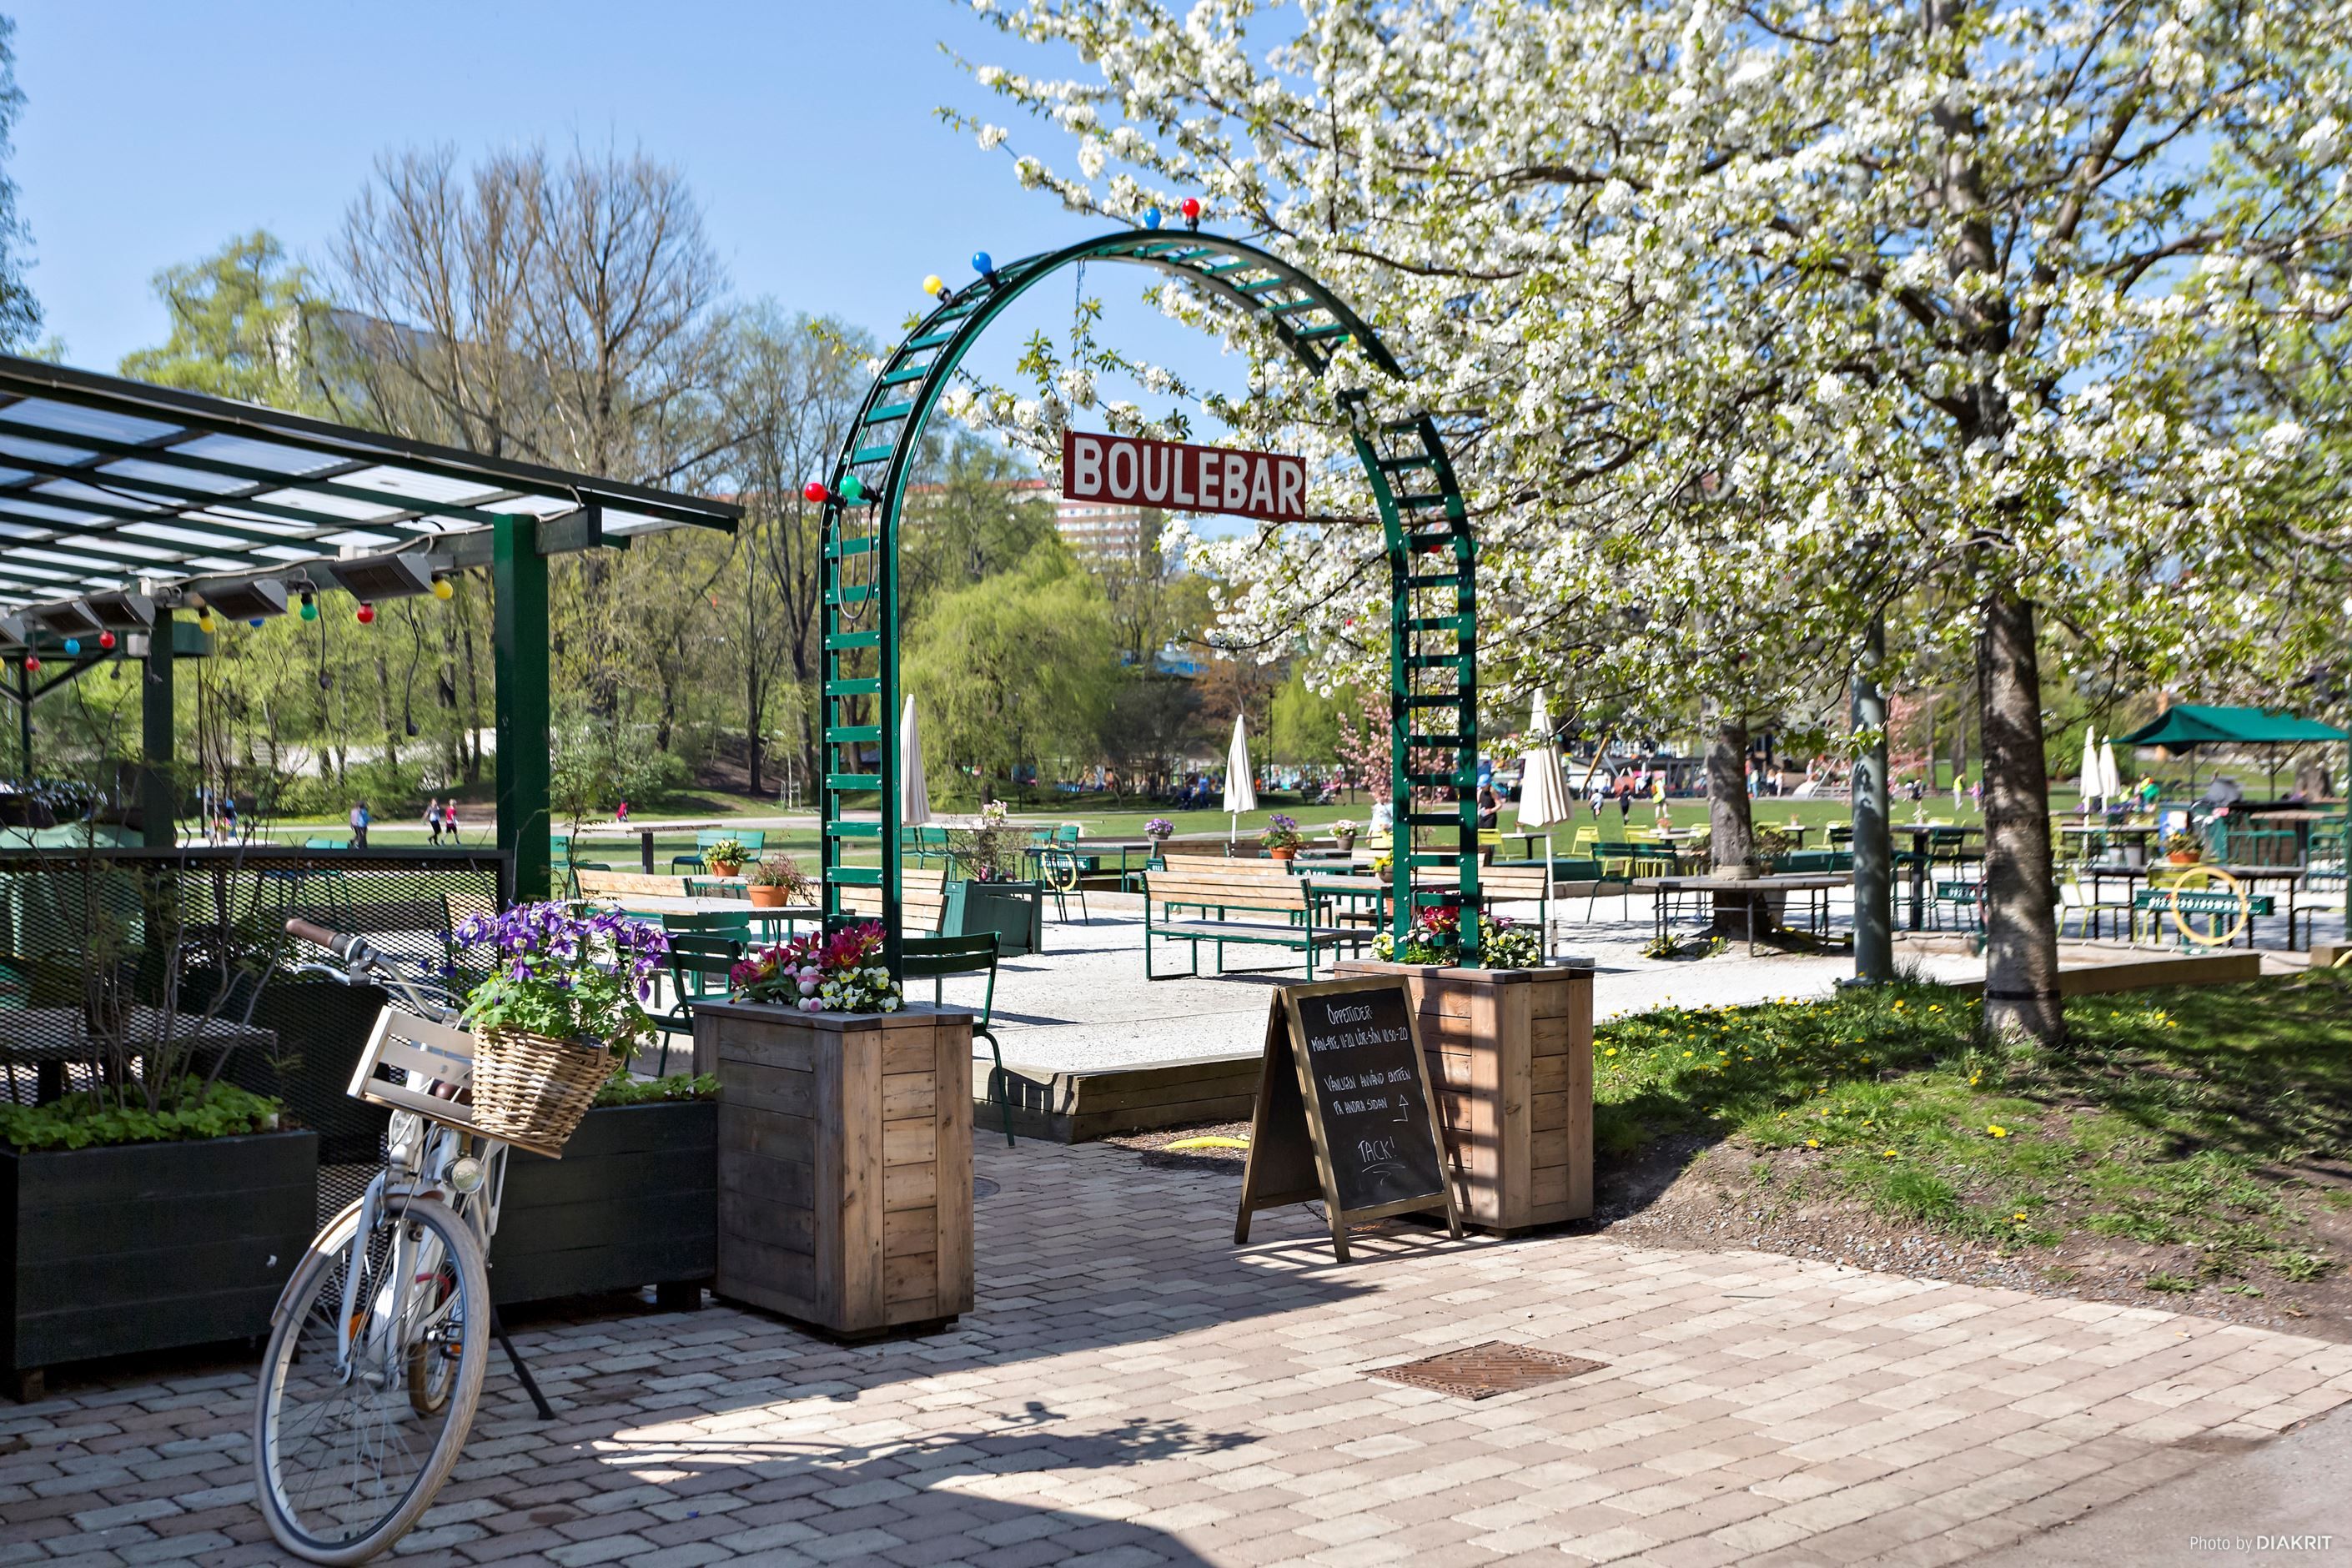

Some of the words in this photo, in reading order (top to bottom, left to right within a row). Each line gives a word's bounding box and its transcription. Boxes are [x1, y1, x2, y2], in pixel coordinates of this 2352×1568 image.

[1073, 436, 1304, 515] BOULEBAR
[1344, 1099, 1366, 1114] ANDRA
[1366, 1097, 1388, 1111] SIDAN
[1358, 1135, 1397, 1163] TACK!
